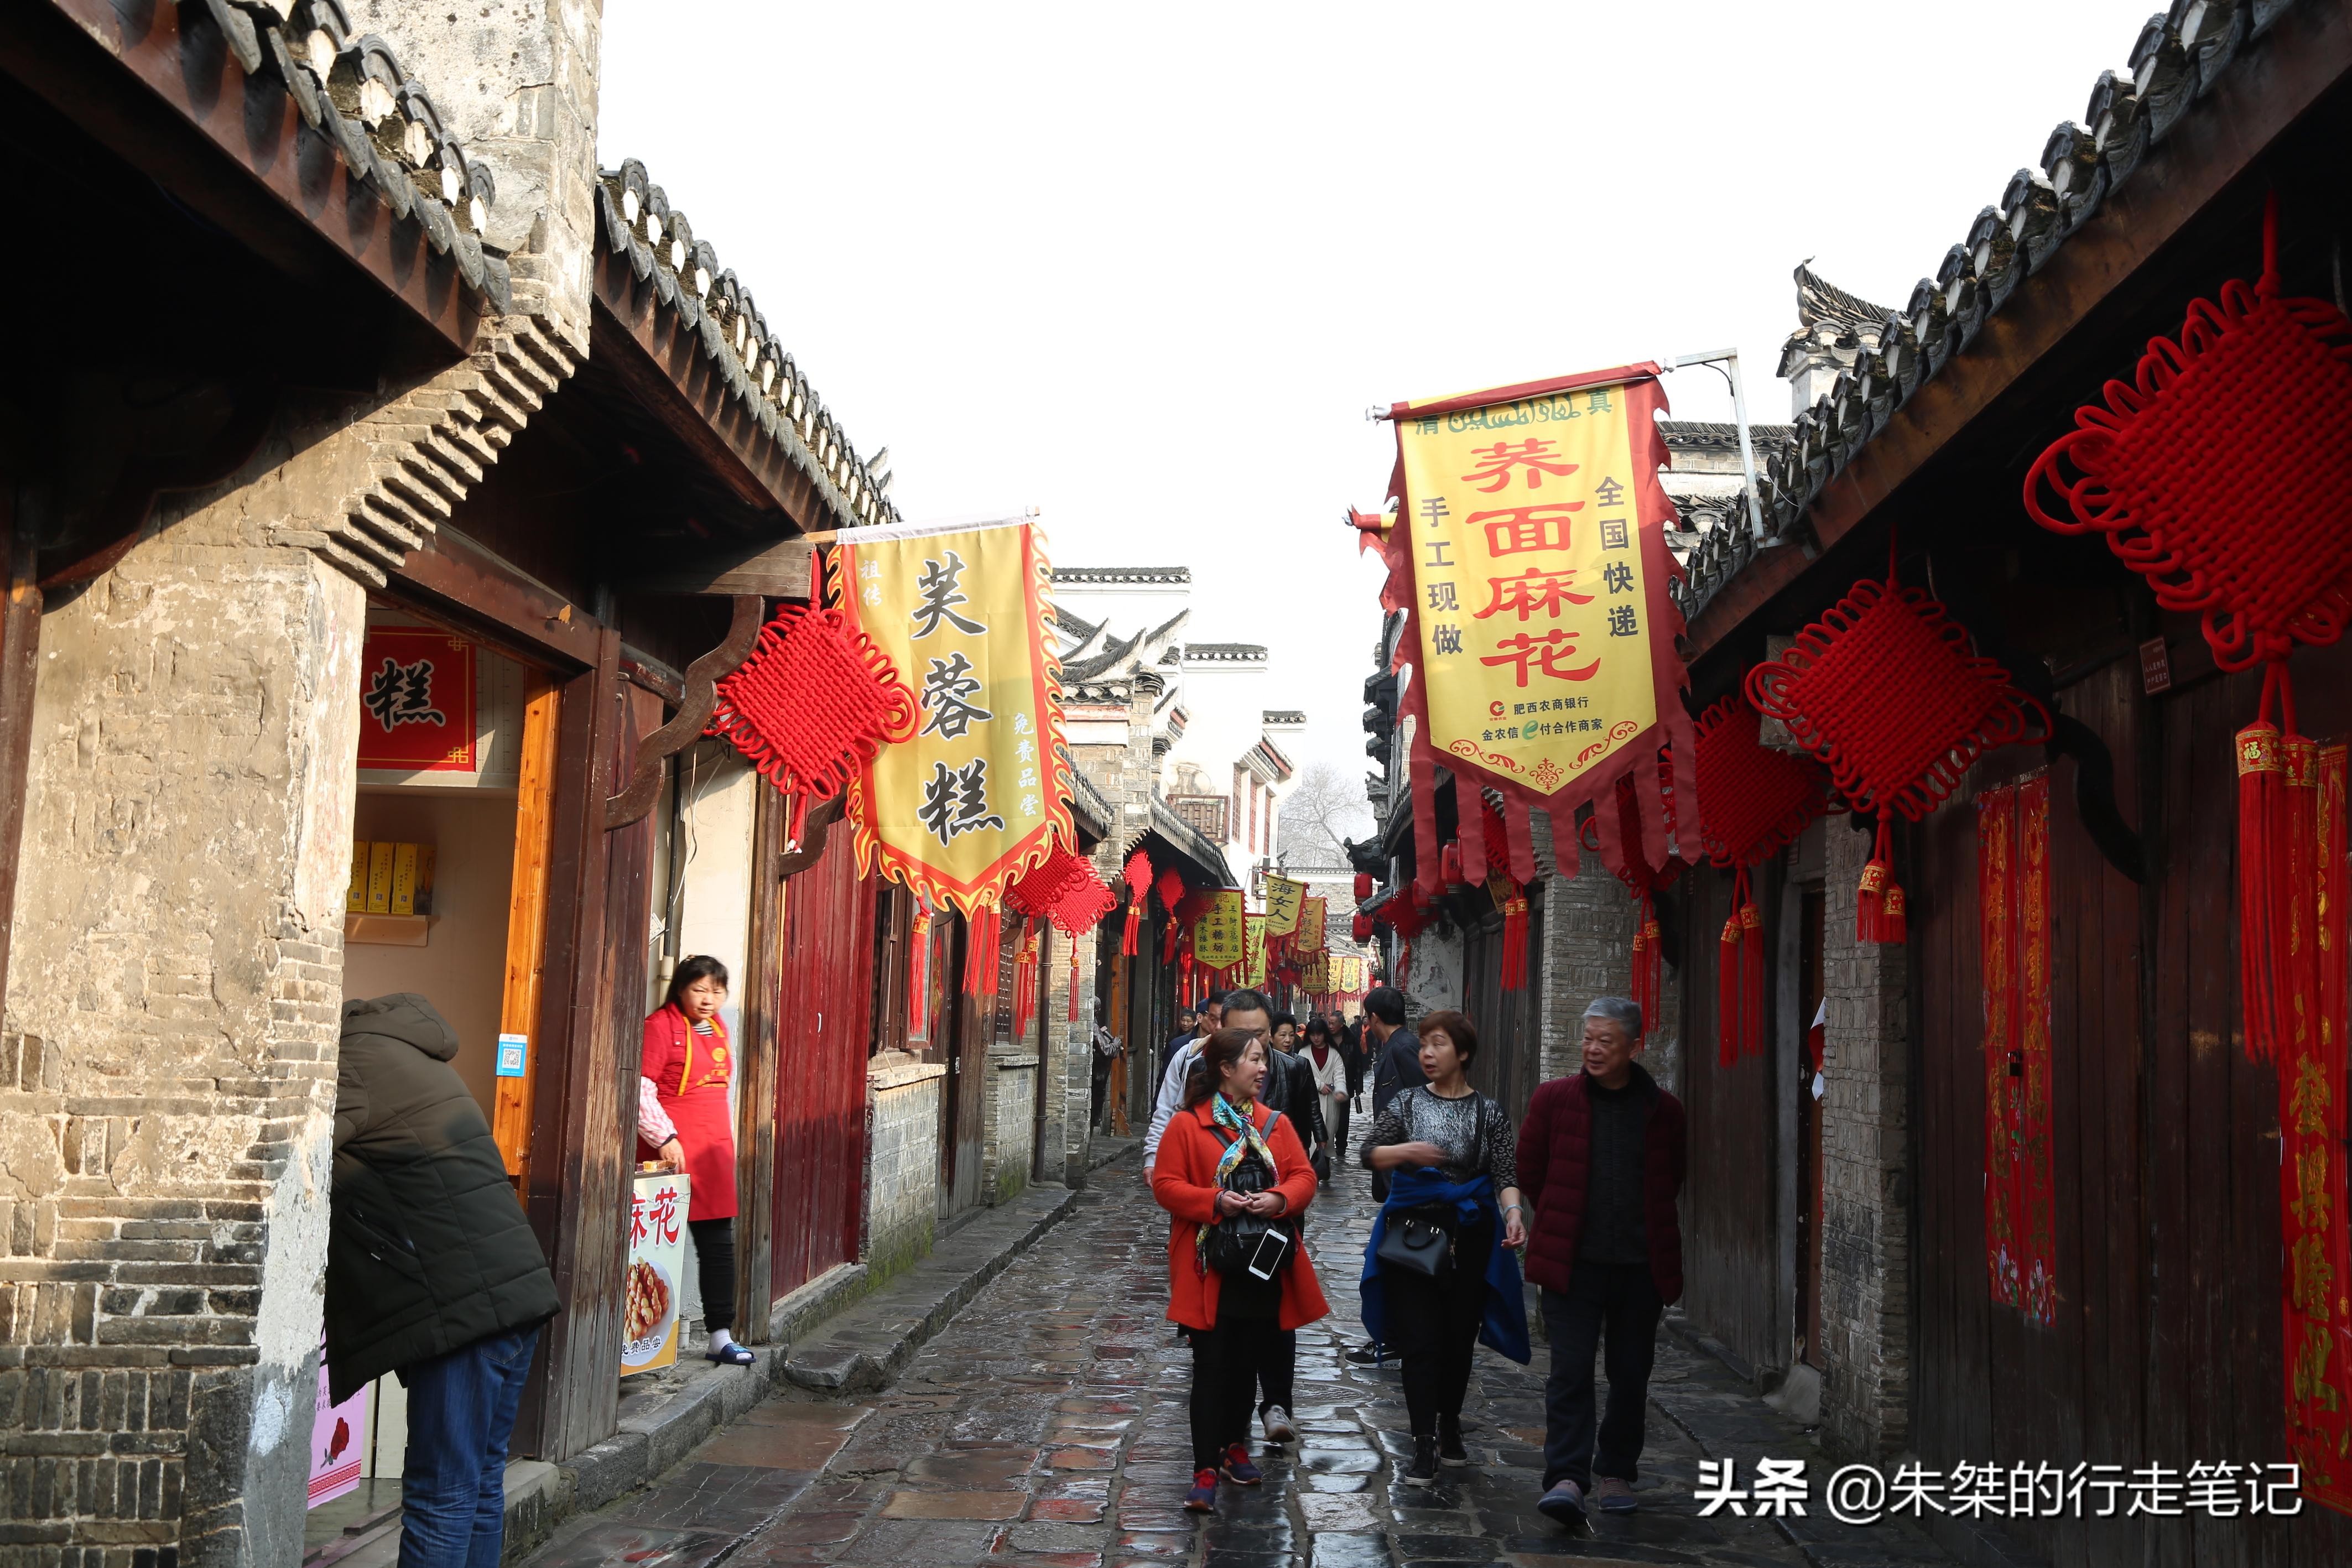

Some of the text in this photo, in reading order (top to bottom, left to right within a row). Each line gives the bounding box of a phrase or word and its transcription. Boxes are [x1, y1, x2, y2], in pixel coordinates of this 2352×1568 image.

[1586, 388, 1612, 415] 真
[1413, 414, 1440, 435] 清
[1420, 496, 1463, 655] 手工现做
[1461, 438, 1600, 687] 荞面麻花
[1595, 476, 1638, 638] 全国快递
[860, 559, 883, 608] 祖传
[363, 657, 446, 733] 糕
[910, 549, 1005, 848] 芙蓉糕
[1514, 696, 1589, 715] 肥西农商银行
[1013, 712, 1039, 817] 免费品尝
[2243, 741, 2261, 760] 福
[1267, 883, 1295, 921] 海女人
[1299, 909, 1314, 947] 七彩水吧
[622, 1336, 661, 1355] 免费品尝
